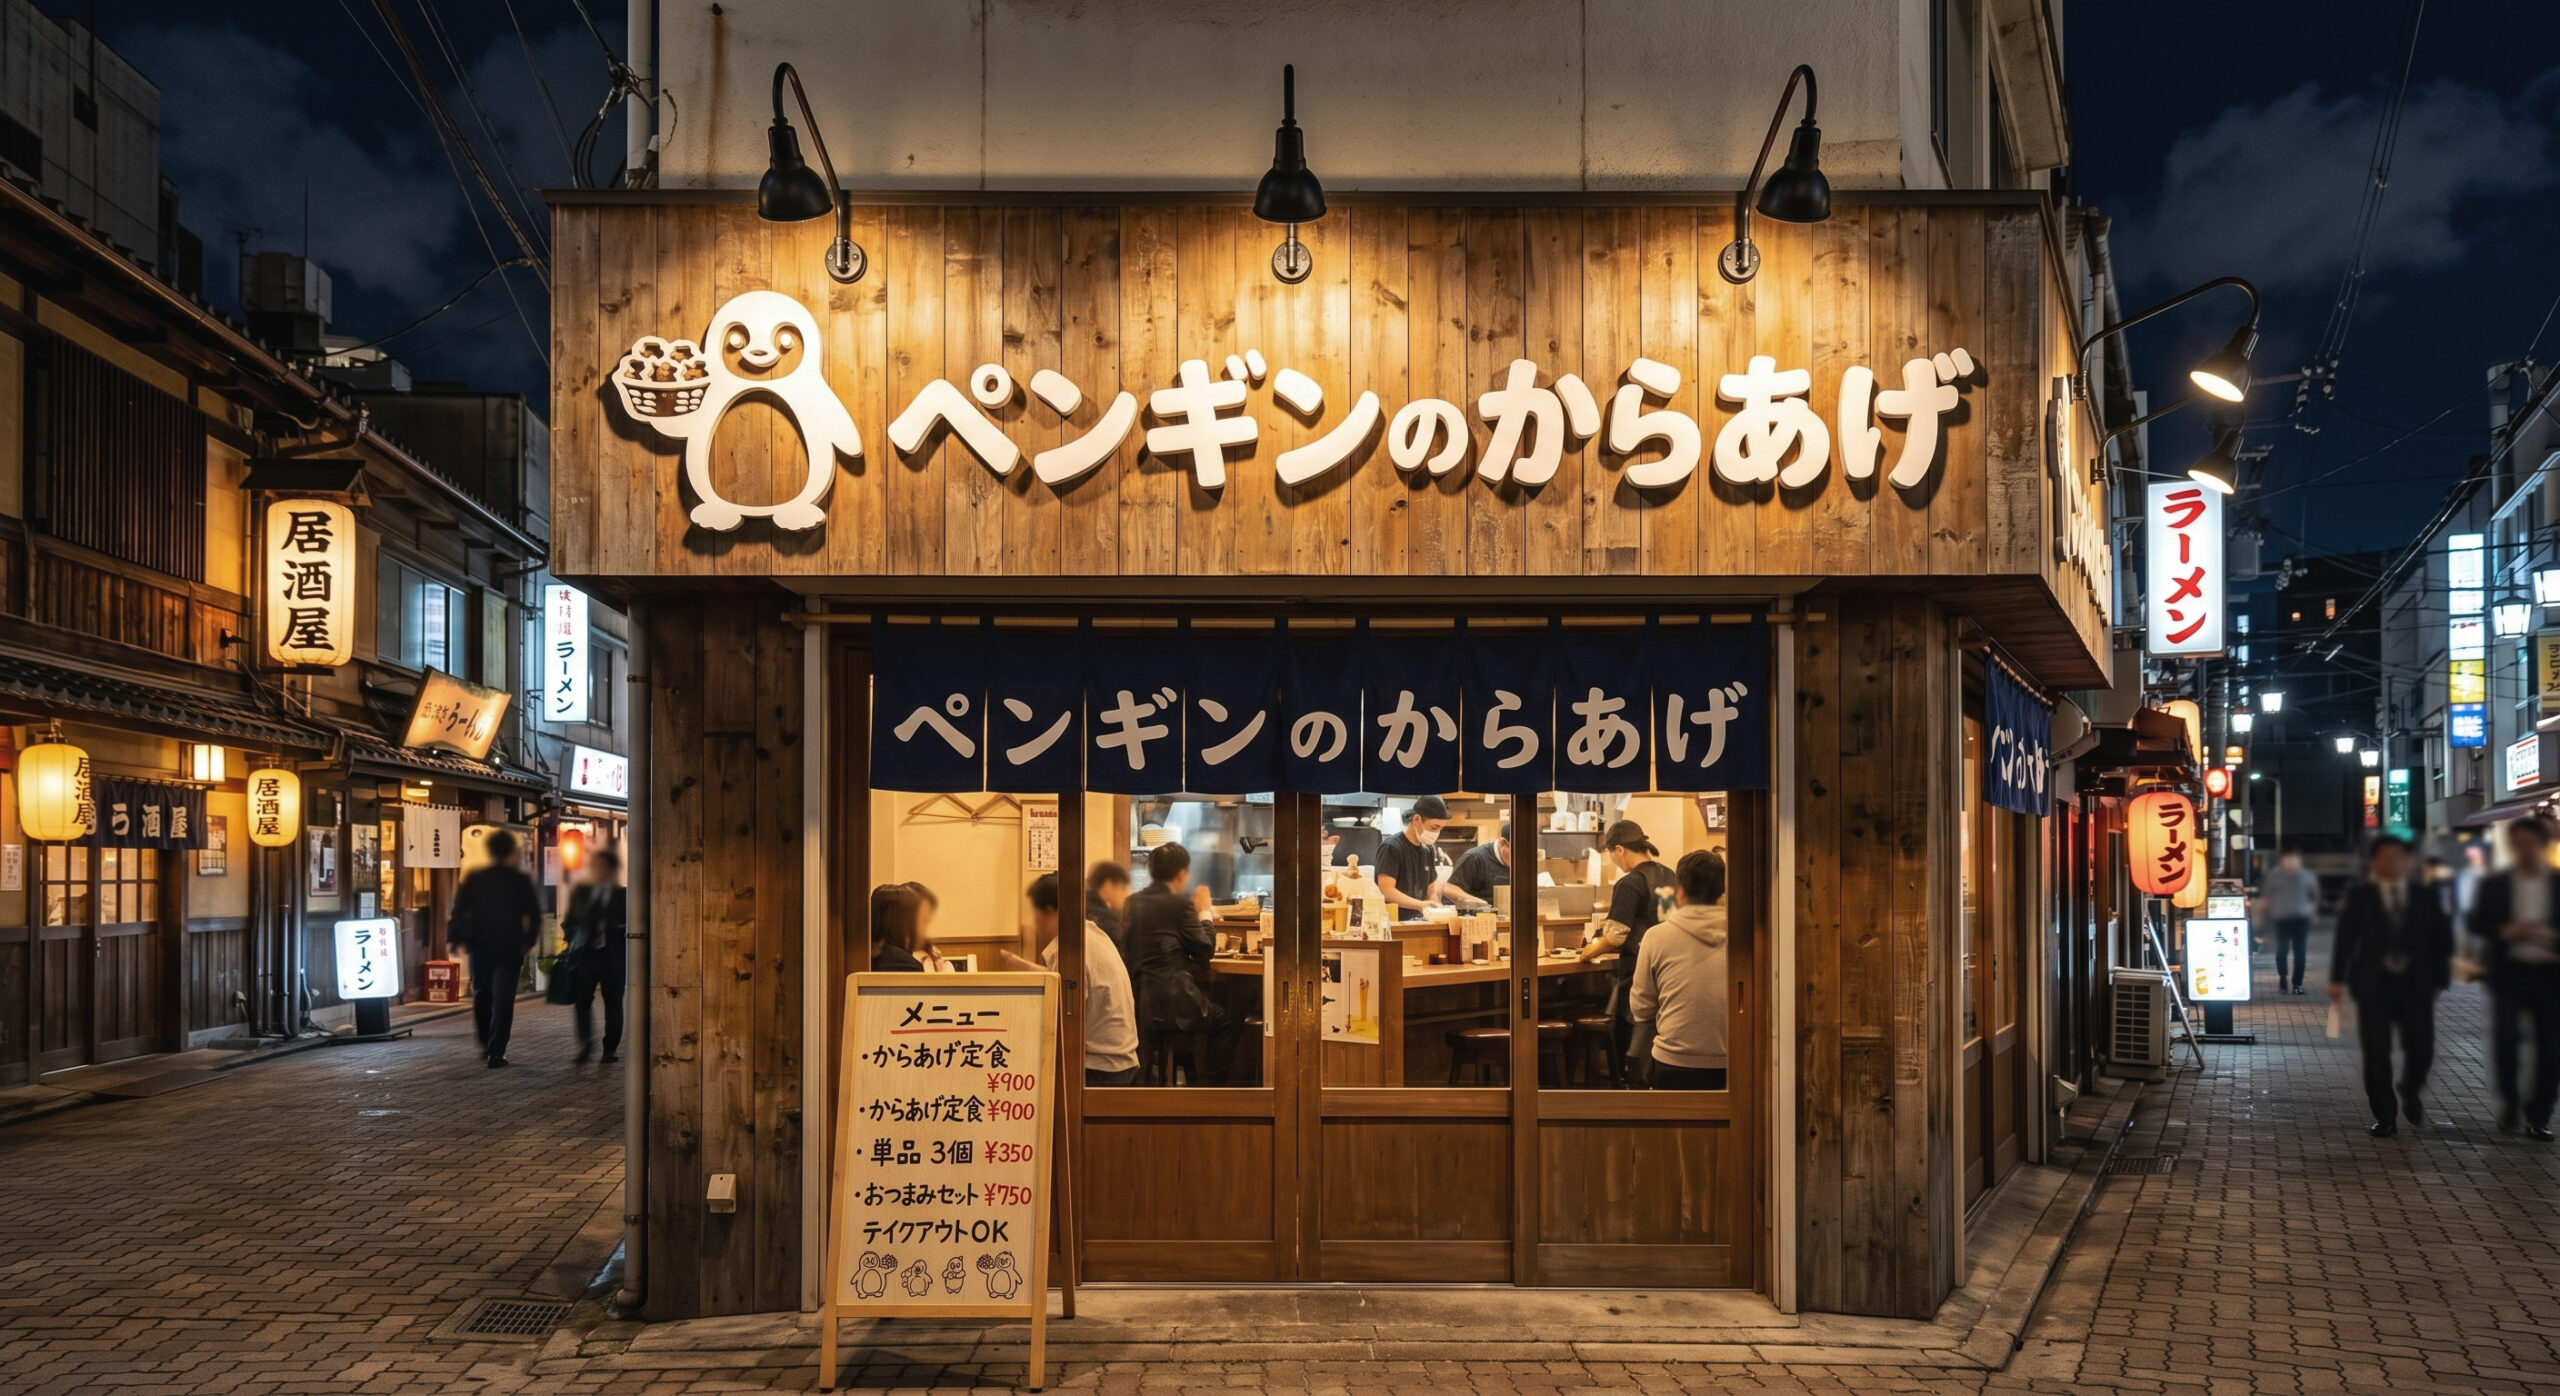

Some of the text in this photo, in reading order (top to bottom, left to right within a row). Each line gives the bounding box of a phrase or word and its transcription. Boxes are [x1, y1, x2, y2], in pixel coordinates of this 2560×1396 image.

[887, 347, 1974, 491] ペンギンのからあげ
[279, 511, 335, 651] 居酒屋
[2163, 489, 2206, 644] ラーメン
[556, 641, 575, 714] ラーメン
[894, 681, 1748, 771] ペンギンのからあげ
[254, 778, 280, 836] 居酒屋
[2157, 802, 2187, 885] ラーメン
[355, 929, 374, 991] ラーメン
[900, 1001, 1000, 1027] メニュー
[873, 1039, 1011, 1070] からあげ定食
[987, 1072, 1035, 1093] ¥900
[869, 1095, 1035, 1123] からあげ定食 ¥900
[871, 1137, 922, 1167] 単品
[984, 1141, 1034, 1164] ¥350
[864, 1182, 1032, 1207] おつまみセット ¥750
[863, 1219, 1009, 1245] テイクアウトOK
